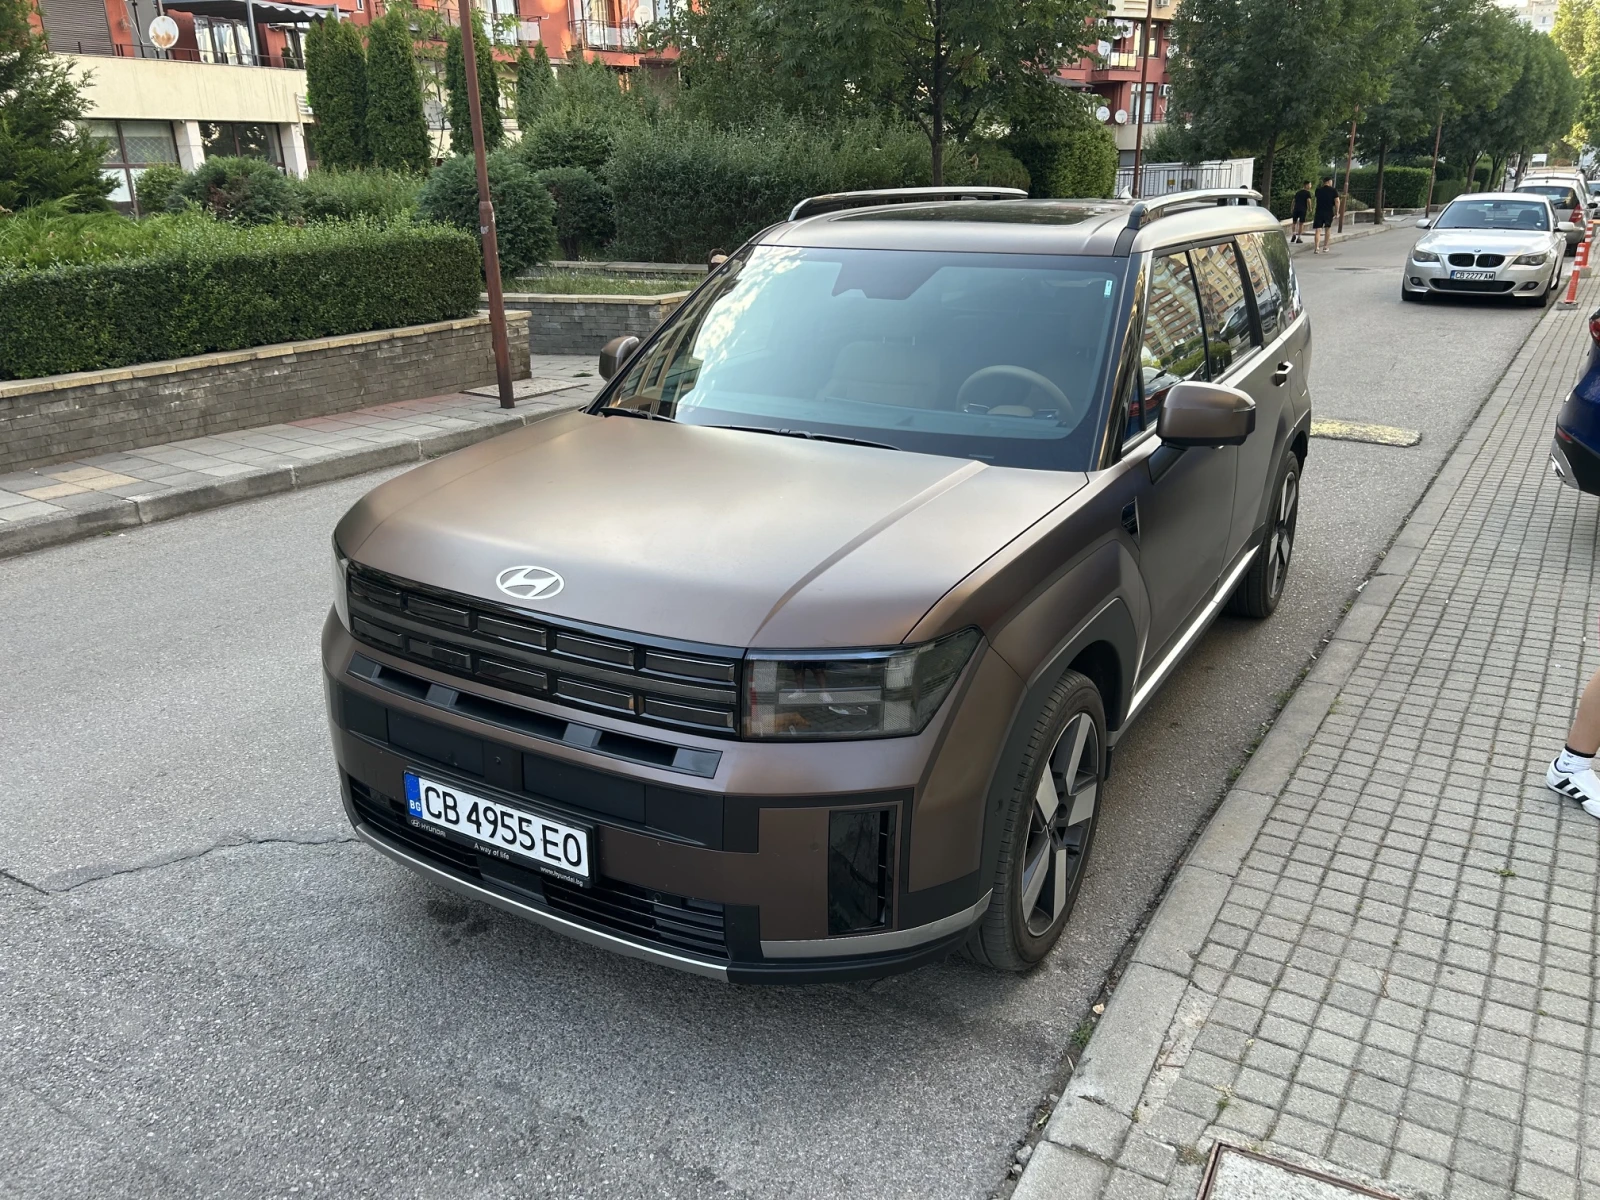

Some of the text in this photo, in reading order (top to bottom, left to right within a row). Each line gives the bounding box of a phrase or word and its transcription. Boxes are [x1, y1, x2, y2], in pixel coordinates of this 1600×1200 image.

[409, 799, 421, 812] BG
[425, 786, 460, 825] CB
[466, 801, 536, 851] 4955
[421, 823, 447, 838] HYUNDAI
[480, 845, 491, 855] way
[500, 851, 510, 860] life
[540, 866, 584, 888] www.hyundai.bg
